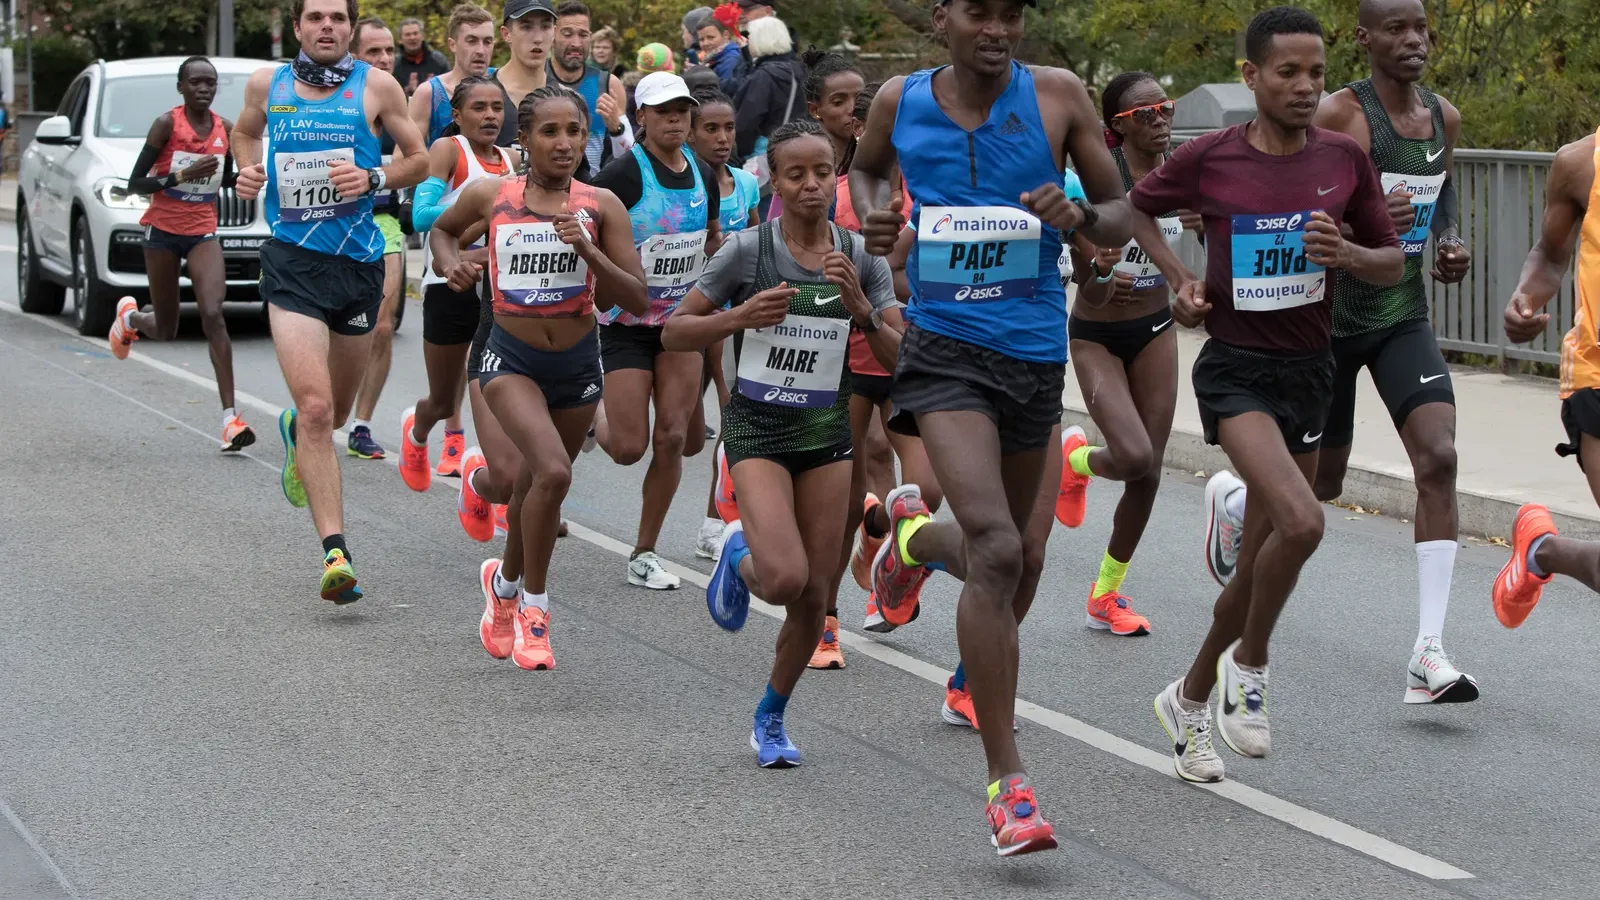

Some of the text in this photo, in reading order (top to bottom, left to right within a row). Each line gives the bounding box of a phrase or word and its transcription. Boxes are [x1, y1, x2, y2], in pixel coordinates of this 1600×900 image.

[290, 119, 355, 131] LAV Stadtwerke
[290, 130, 355, 143] TÜBINGEN
[301, 178, 330, 187] Lorenz
[312, 208, 335, 219] asics
[953, 216, 1029, 231] mainova
[1255, 217, 1287, 230] asics
[523, 230, 558, 243] main
[1274, 233, 1286, 246] 72
[223, 239, 242, 248] DER
[664, 237, 702, 251] mainova
[949, 241, 1009, 271] PACE
[1253, 246, 1308, 277] PACE
[508, 252, 579, 275] ABEBECH
[653, 253, 697, 275] BEDATU
[539, 278, 549, 288] F9
[972, 272, 985, 284] 84
[1136, 278, 1156, 288] asics
[537, 291, 563, 302] asics
[970, 286, 1003, 299] asics
[1236, 284, 1305, 301] mainova
[774, 325, 838, 341] mainova
[765, 346, 819, 374] MARE
[783, 376, 795, 388] F2
[778, 391, 808, 404] asics
